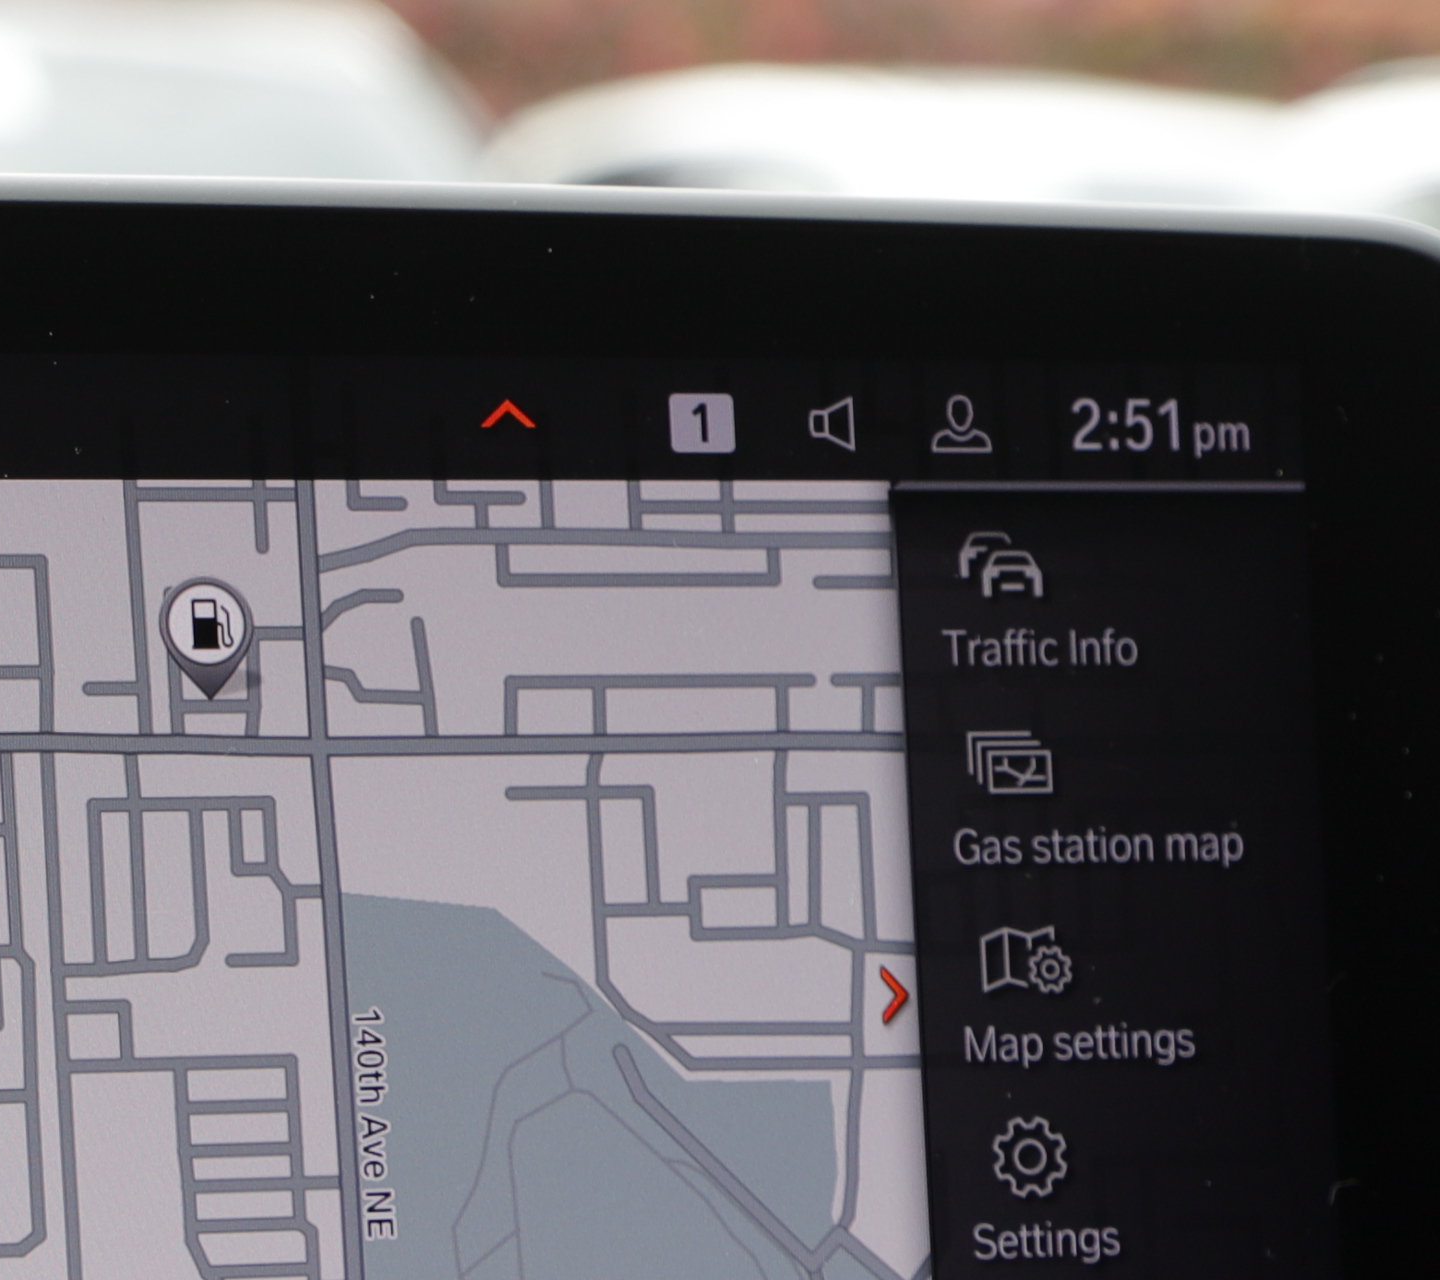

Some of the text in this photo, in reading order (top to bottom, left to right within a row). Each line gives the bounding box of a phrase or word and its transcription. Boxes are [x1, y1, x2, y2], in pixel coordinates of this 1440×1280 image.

[1070, 397, 1251, 458] 2:51 pm
[942, 627, 1140, 669] Traffic Info
[953, 825, 1245, 868] Gas station map
[963, 1023, 1196, 1068] Map settings
[354, 1008, 395, 1238] 140th Ave NE
[972, 1221, 1121, 1264] Settings
